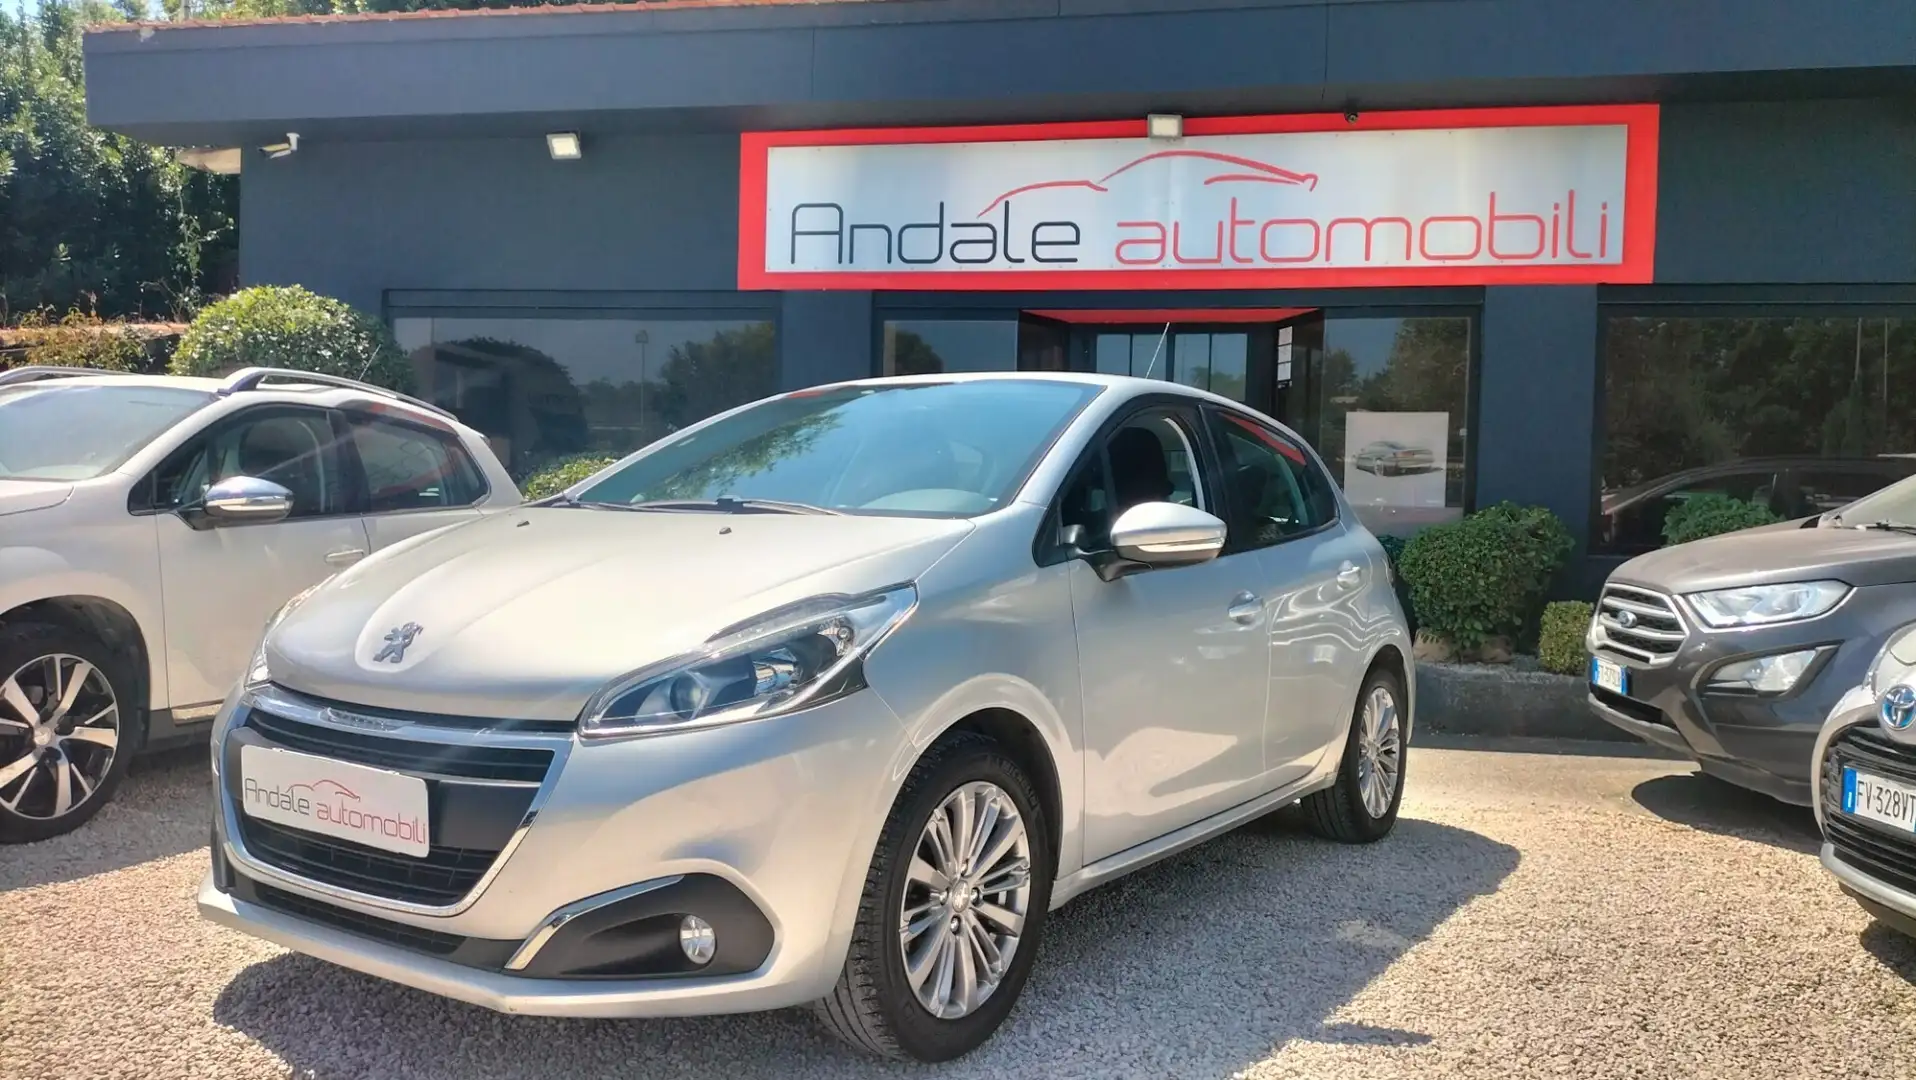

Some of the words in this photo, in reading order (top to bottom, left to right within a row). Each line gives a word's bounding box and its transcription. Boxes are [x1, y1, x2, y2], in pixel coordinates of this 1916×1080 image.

[790, 200, 1081, 265] Andale
[1114, 188, 1608, 265] automobili
[244, 777, 311, 817] Andale
[316, 801, 427, 846] automobili
